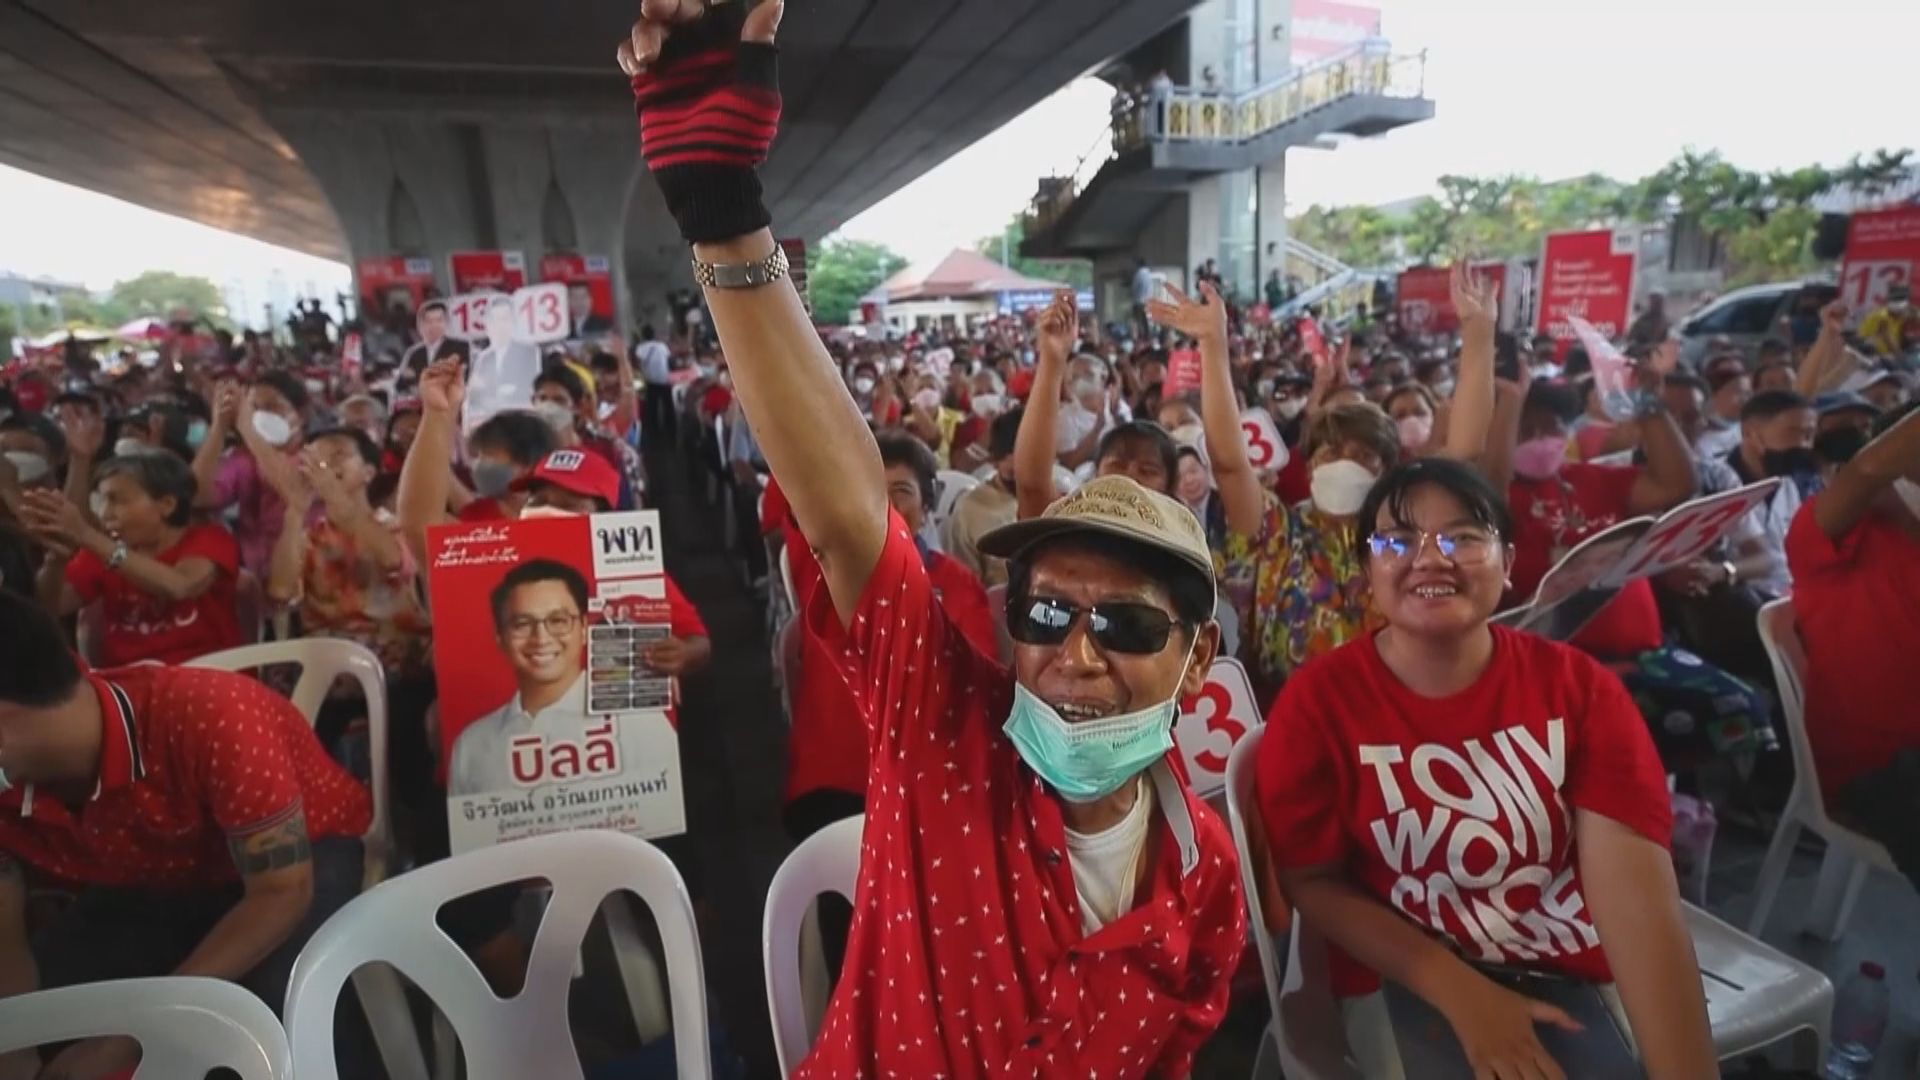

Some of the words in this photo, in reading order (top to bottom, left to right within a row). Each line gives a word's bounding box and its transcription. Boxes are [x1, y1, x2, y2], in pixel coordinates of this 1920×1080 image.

[1850, 266, 1905, 304] 13
[453, 298, 487, 332] 13
[520, 292, 562, 336] 13
[597, 525, 653, 554] พท
[1626, 498, 1748, 575] 13
[512, 713, 616, 783] บิลลี่
[463, 789, 536, 821] จิรวัฒน์
[544, 775, 668, 810] อรัณยกานนท์
[1358, 718, 1566, 863] TONY
